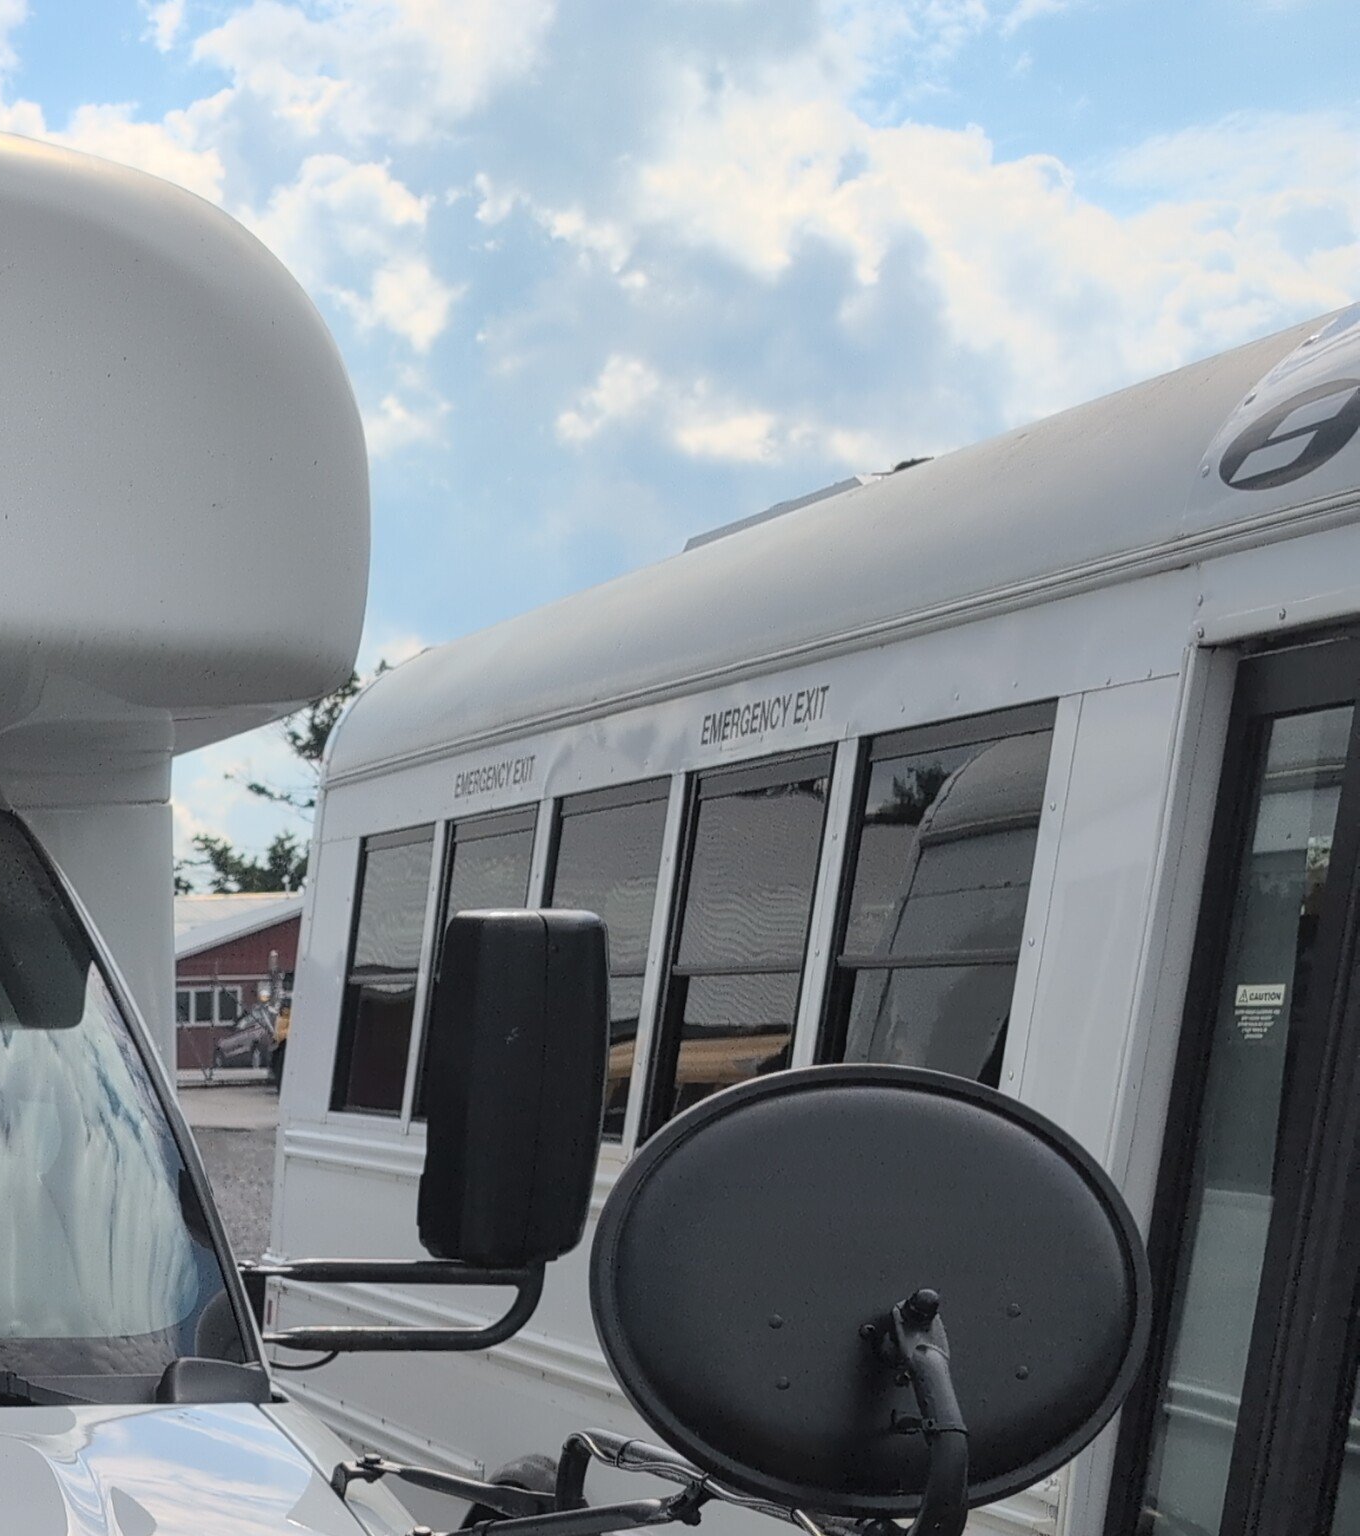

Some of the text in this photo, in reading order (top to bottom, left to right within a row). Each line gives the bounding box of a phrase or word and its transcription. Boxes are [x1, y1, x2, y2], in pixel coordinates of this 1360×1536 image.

[701, 685, 830, 746] EMERGENCY EXIT
[454, 754, 537, 799] EMERGENCY EXIT
[1249, 991, 1282, 1002] CAUTION
